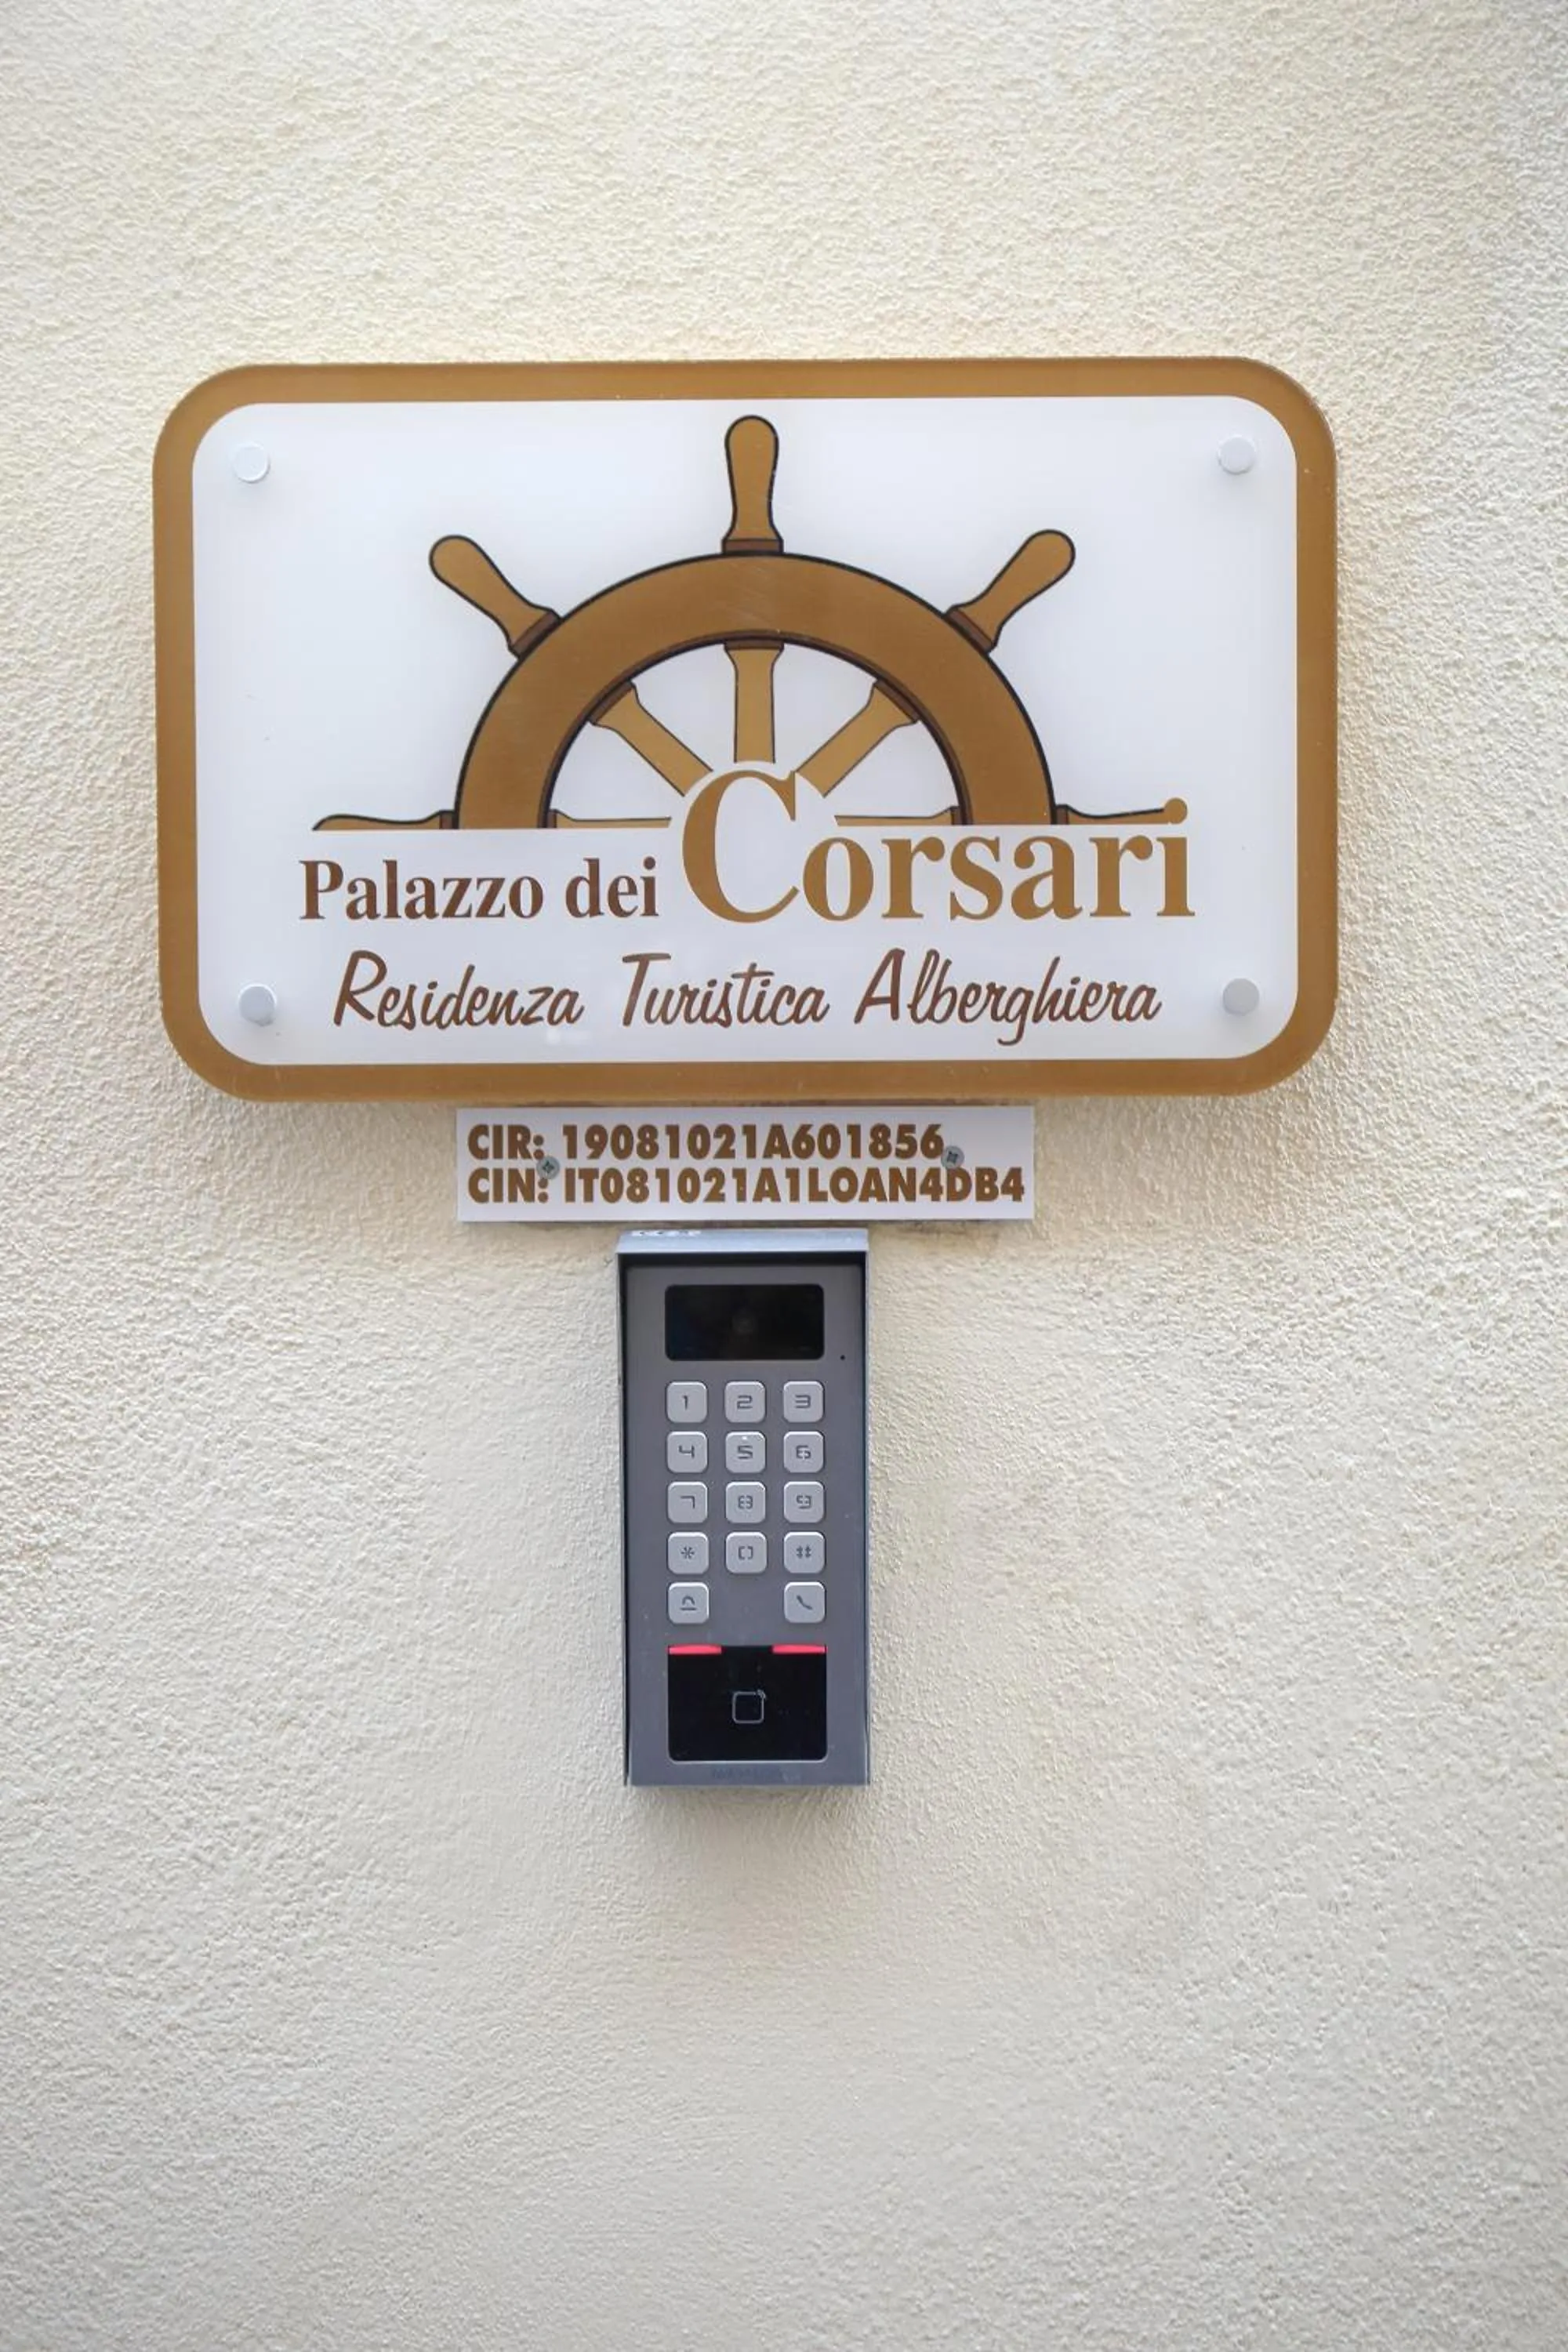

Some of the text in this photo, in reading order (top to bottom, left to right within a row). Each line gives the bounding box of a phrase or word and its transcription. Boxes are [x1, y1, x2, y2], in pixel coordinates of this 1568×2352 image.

[298, 770, 1196, 924] Palazzo dei Corsari
[332, 947, 1163, 1047] Residenza Turistica Alberghiera
[467, 1123, 945, 1160] CIR: 19081021A601856
[467, 1167, 1025, 1204] CIN: IT081021A1LOAN4DB4
[681, 1394, 811, 1410] 1 2 3
[678, 1444, 812, 1460] 4 5 6
[680, 1494, 812, 1510] 7 8 9
